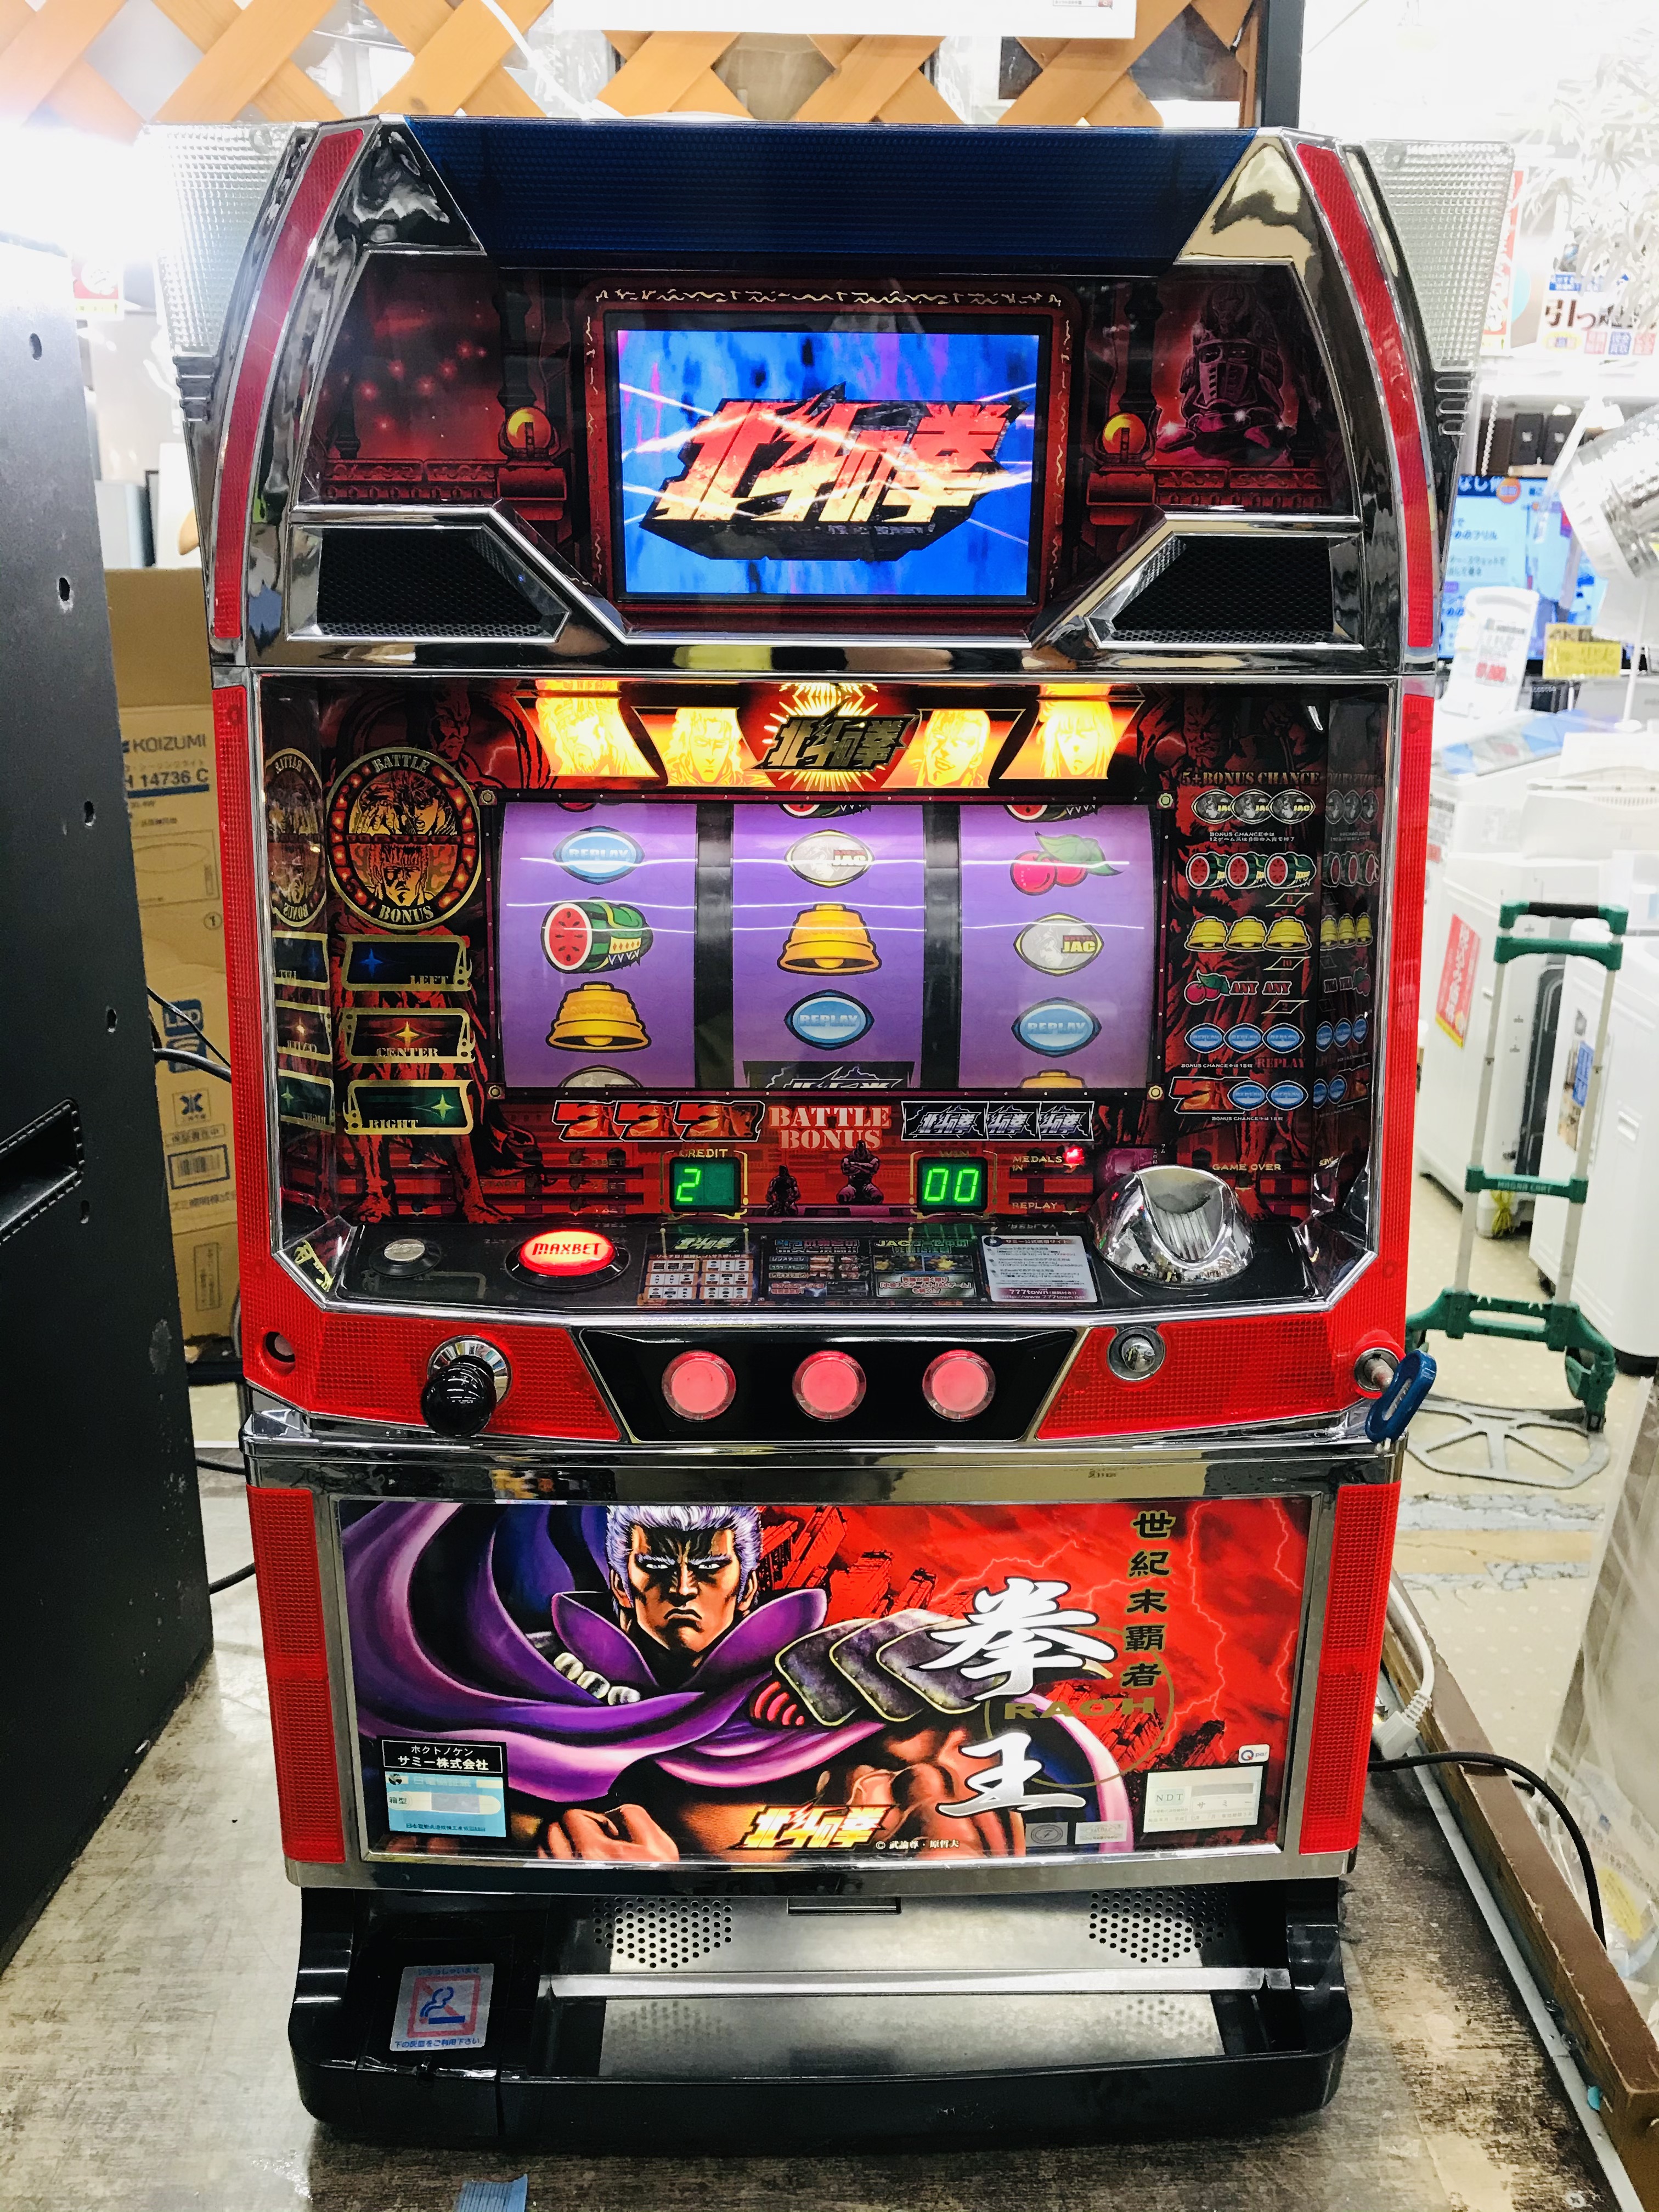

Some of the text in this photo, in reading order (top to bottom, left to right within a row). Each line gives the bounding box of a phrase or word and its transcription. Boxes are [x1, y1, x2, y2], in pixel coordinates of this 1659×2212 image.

[133, 733, 206, 753] KOIZUMI
[768, 715, 906, 768] 北斗の拳
[371, 754, 431, 774] BATTLE
[140, 770, 190, 787] 14736
[196, 768, 209, 782] C
[1257, 771, 1319, 785] CHANCE
[378, 905, 435, 923] BONUS
[1062, 940, 1096, 952] JAC
[410, 975, 449, 985] LEFT
[1231, 982, 1291, 994] ANY ANY
[799, 1014, 859, 1026] REPLAY
[1026, 1020, 1086, 1036] REPLAY
[376, 1047, 439, 1057] CENTER
[1256, 1058, 1305, 1069] REPLAY
[369, 1119, 419, 1128] RIGHT
[769, 1106, 891, 1127] BATTLE
[780, 1130, 881, 1149] BONUS
[680, 1148, 729, 1158] CREDIT
[675, 1168, 702, 1202] 2
[924, 1168, 979, 1202] 00
[532, 1242, 603, 1256] MAXBET
[1122, 1510, 1175, 1690] 世紀末覇者
[915, 1577, 1117, 1816] 拳王
[1003, 1697, 1155, 1720] RAOH
[411, 1745, 474, 1757] ホクトノケン
[397, 1755, 489, 1771] サミー株式会社
[389, 1797, 408, 1805] 箱型
[1156, 1793, 1184, 1802] NDT
[744, 1806, 887, 1848] 北斗の拳
